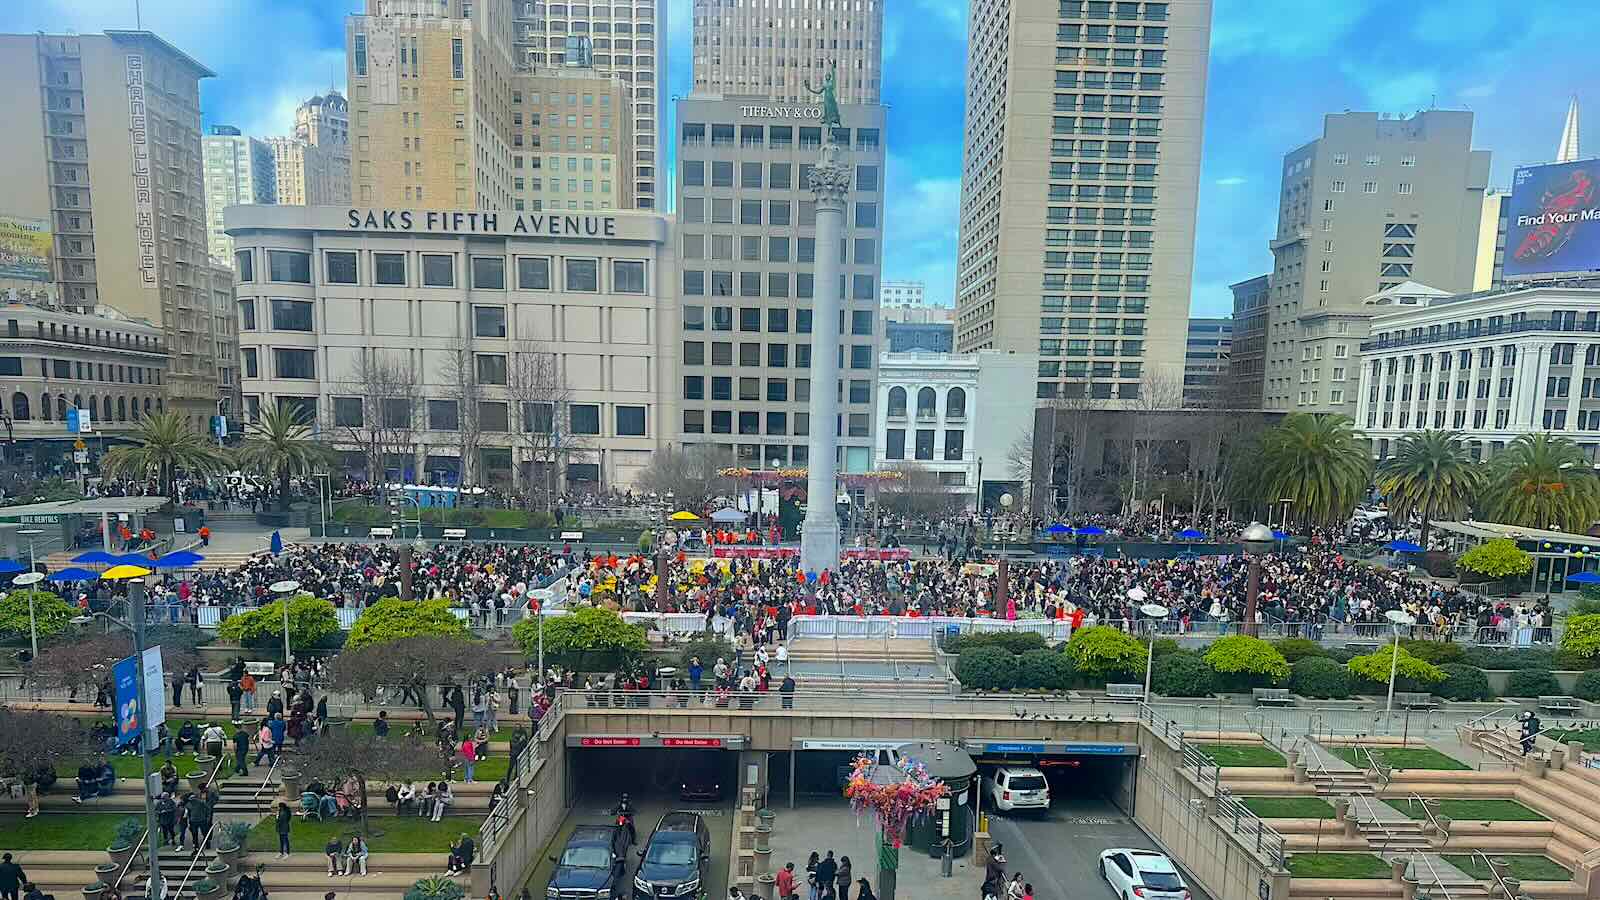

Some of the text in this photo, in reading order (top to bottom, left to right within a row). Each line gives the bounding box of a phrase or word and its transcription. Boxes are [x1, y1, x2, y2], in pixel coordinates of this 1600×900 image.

[740, 105, 792, 118] TIFFANY
[793, 106, 802, 118] &
[127, 55, 156, 283] CHANCELLOR HOTEL
[348, 209, 616, 236] SAKS FIFTH AVENUE
[1517, 214, 1545, 227] Find
[1546, 211, 1578, 223] Your
[20, 514, 59, 524] BIKE RENTALS
